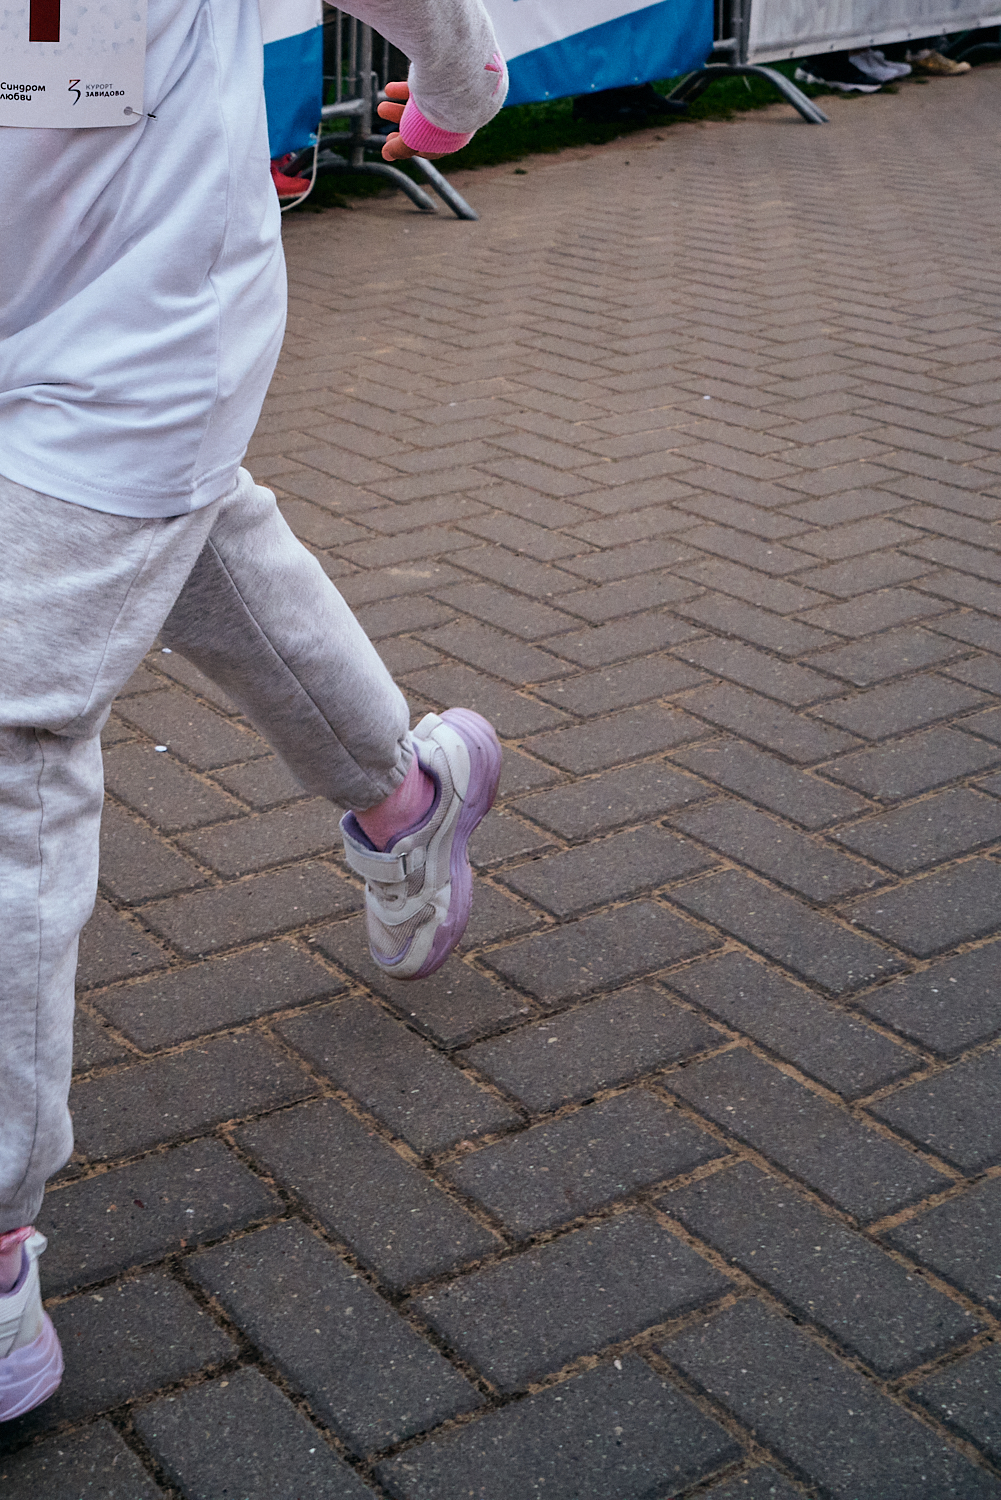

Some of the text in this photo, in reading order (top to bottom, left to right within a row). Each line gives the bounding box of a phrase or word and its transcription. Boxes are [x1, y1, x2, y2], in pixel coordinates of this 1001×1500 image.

[0, 82, 46, 93] Синдром
[0, 93, 32, 101] любви
[85, 90, 125, 98] ЗАВИДОВО
